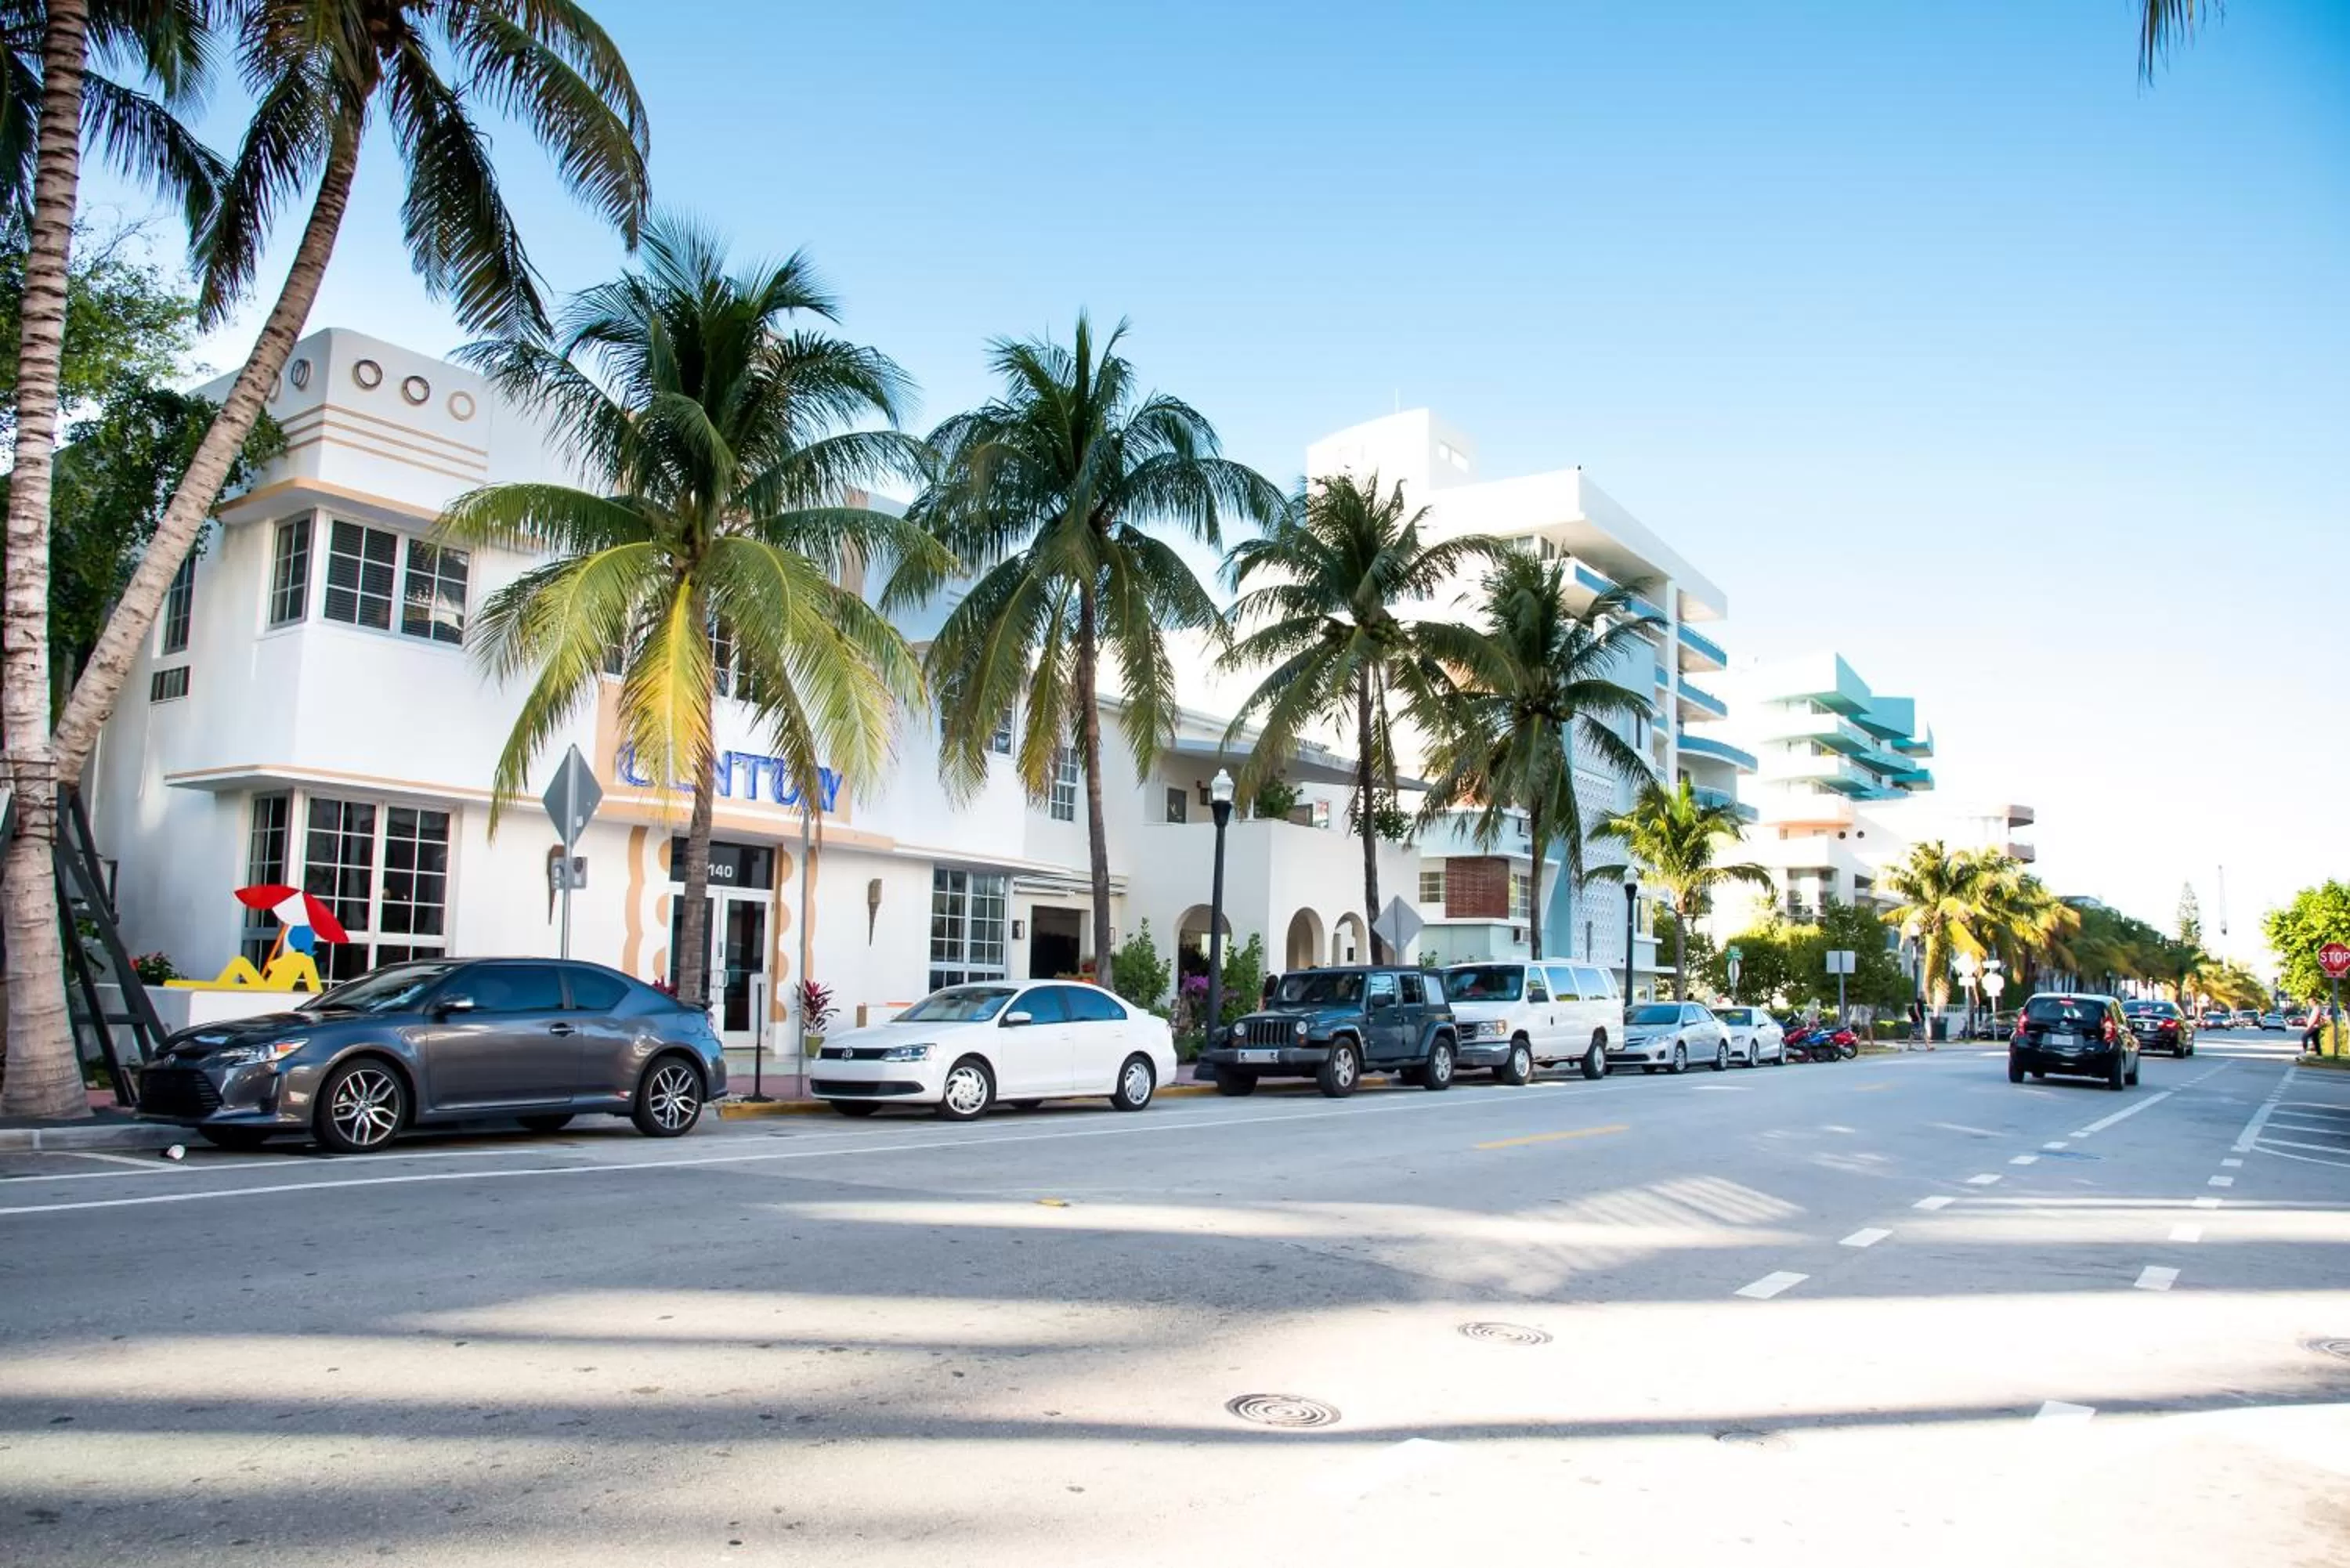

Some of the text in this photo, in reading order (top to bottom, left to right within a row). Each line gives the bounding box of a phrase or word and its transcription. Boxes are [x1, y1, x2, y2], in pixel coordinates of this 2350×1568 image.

[614, 739, 843, 812] CNTUY
[707, 864, 732, 878] 140
[2319, 952, 2350, 963] STOP
